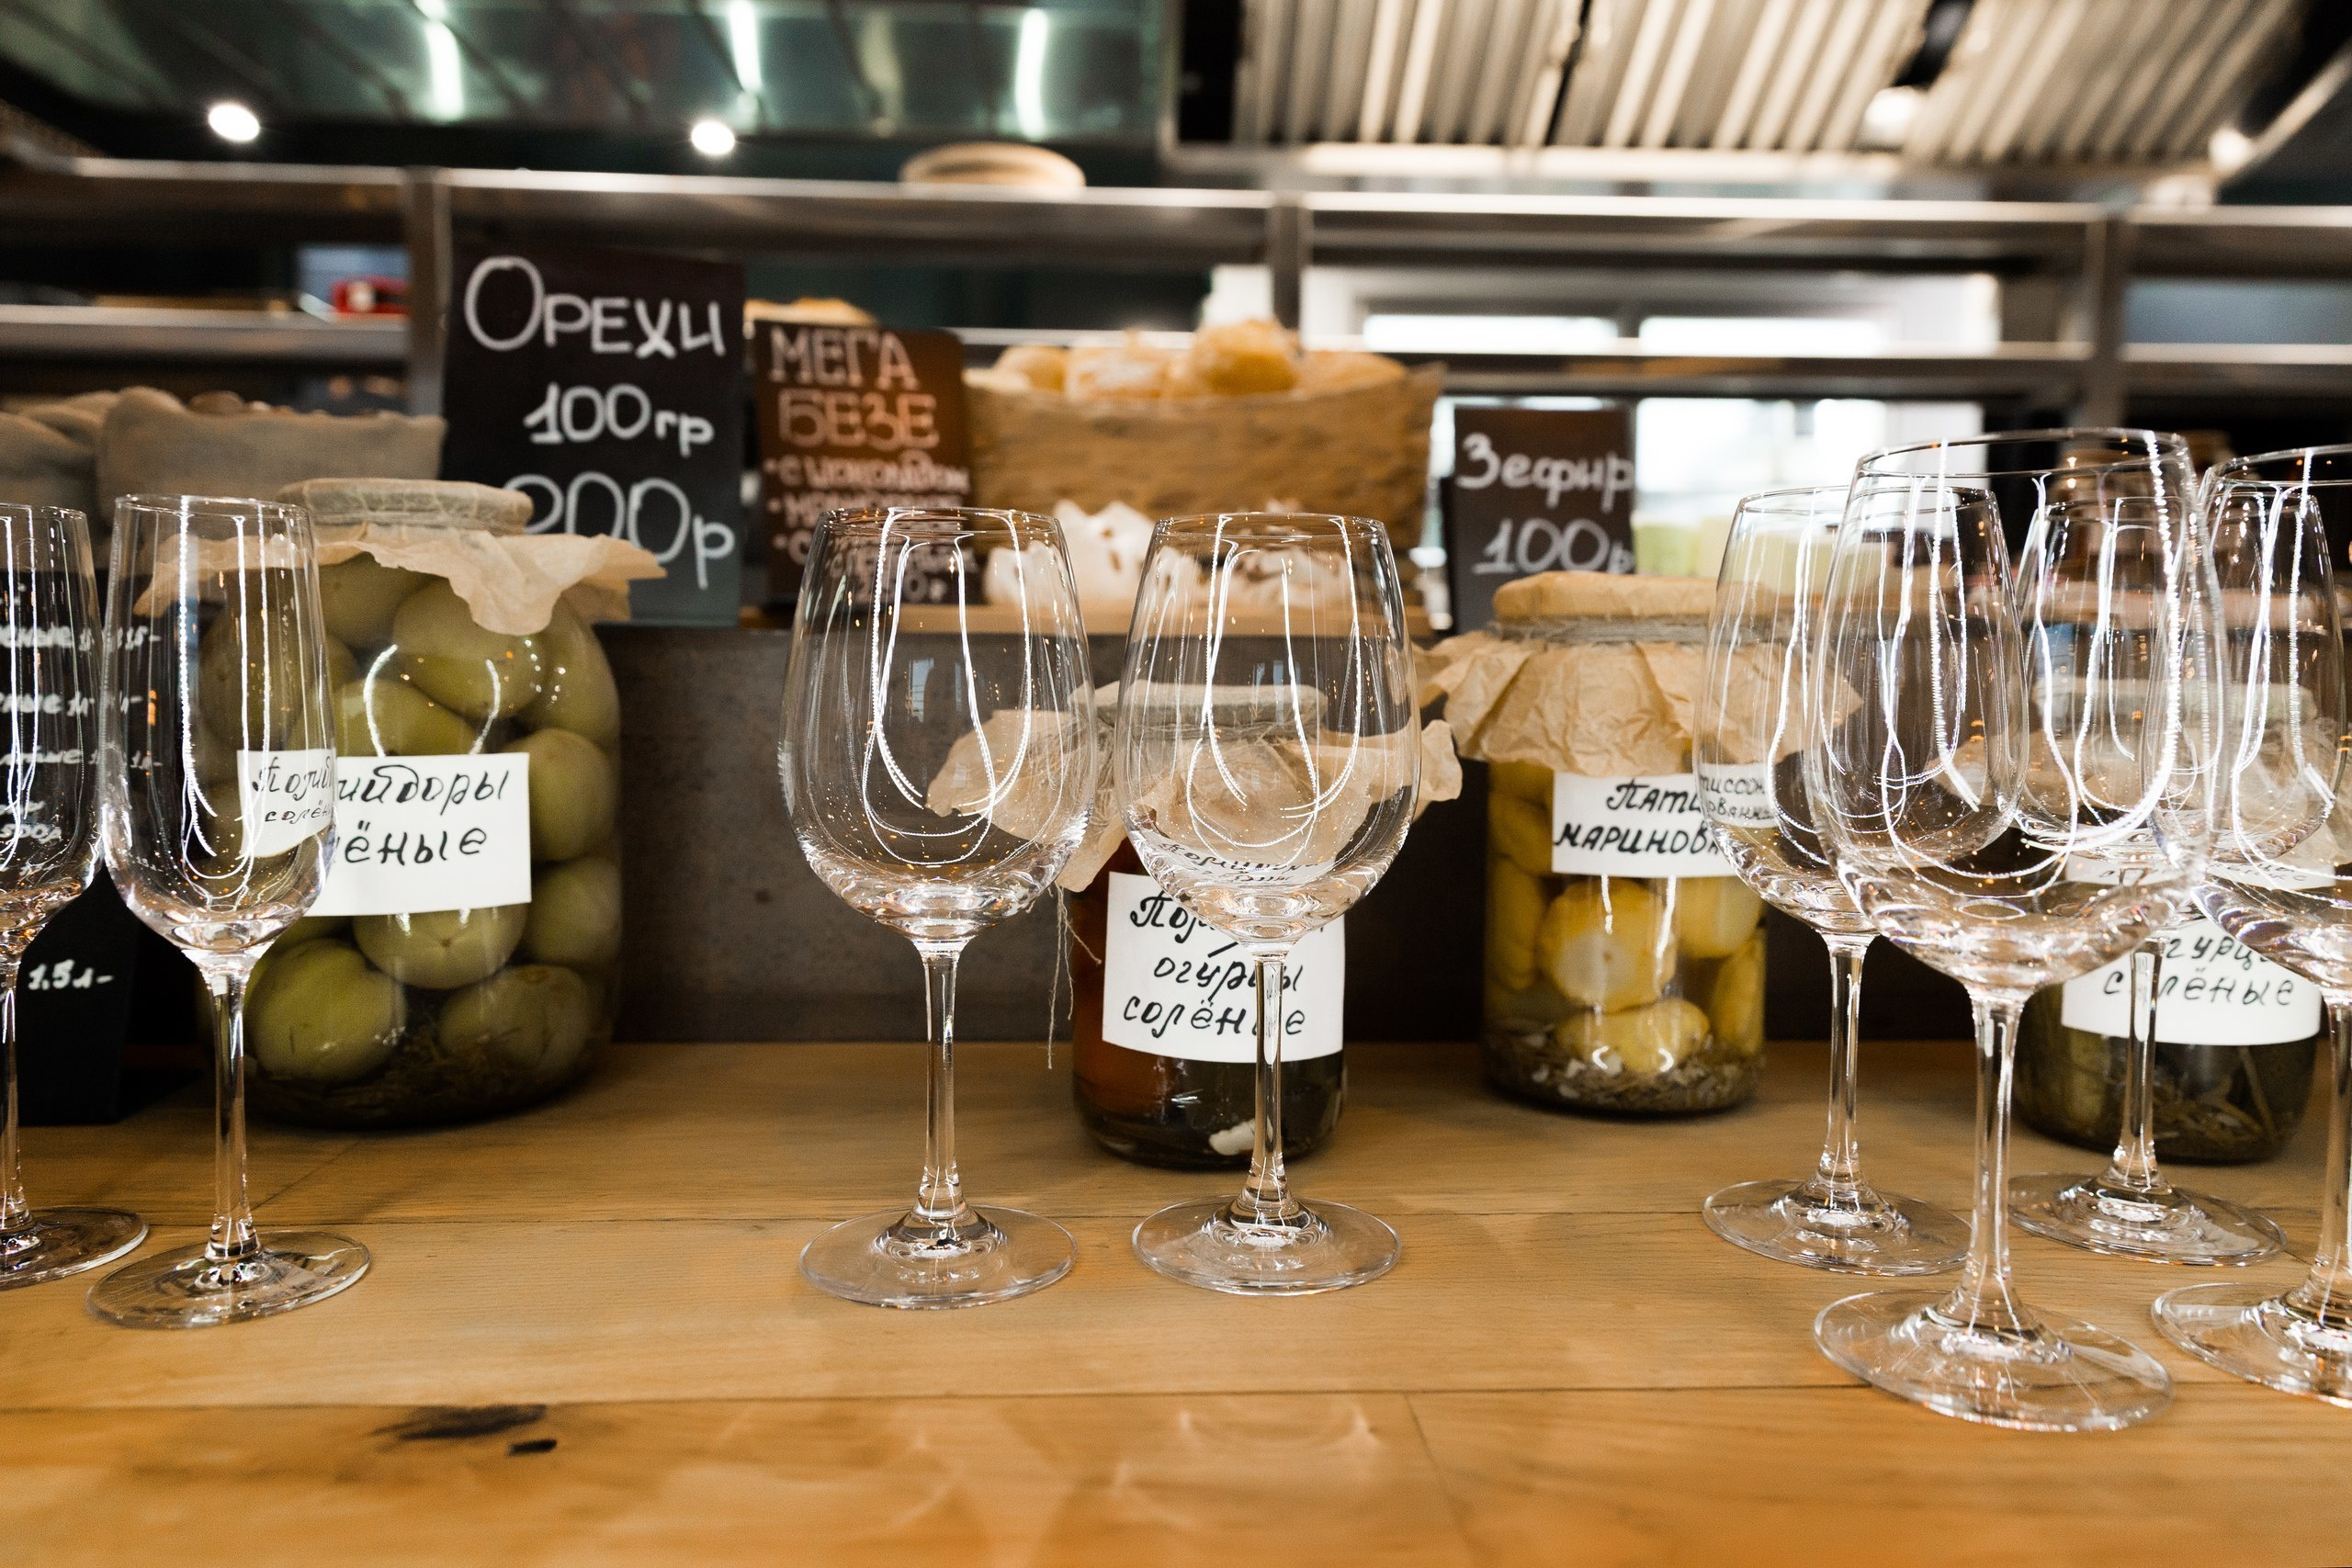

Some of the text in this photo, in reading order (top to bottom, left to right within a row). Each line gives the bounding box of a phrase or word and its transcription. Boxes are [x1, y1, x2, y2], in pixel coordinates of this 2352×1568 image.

[769, 326, 920, 391] МЕГА
[523, 382, 715, 457] 100гр
[777, 388, 941, 451] БЕЗЕ
[1454, 432, 1635, 513] Зефир
[1123, 995, 1306, 1039] солёне
[2103, 966, 2295, 1006] слёные
